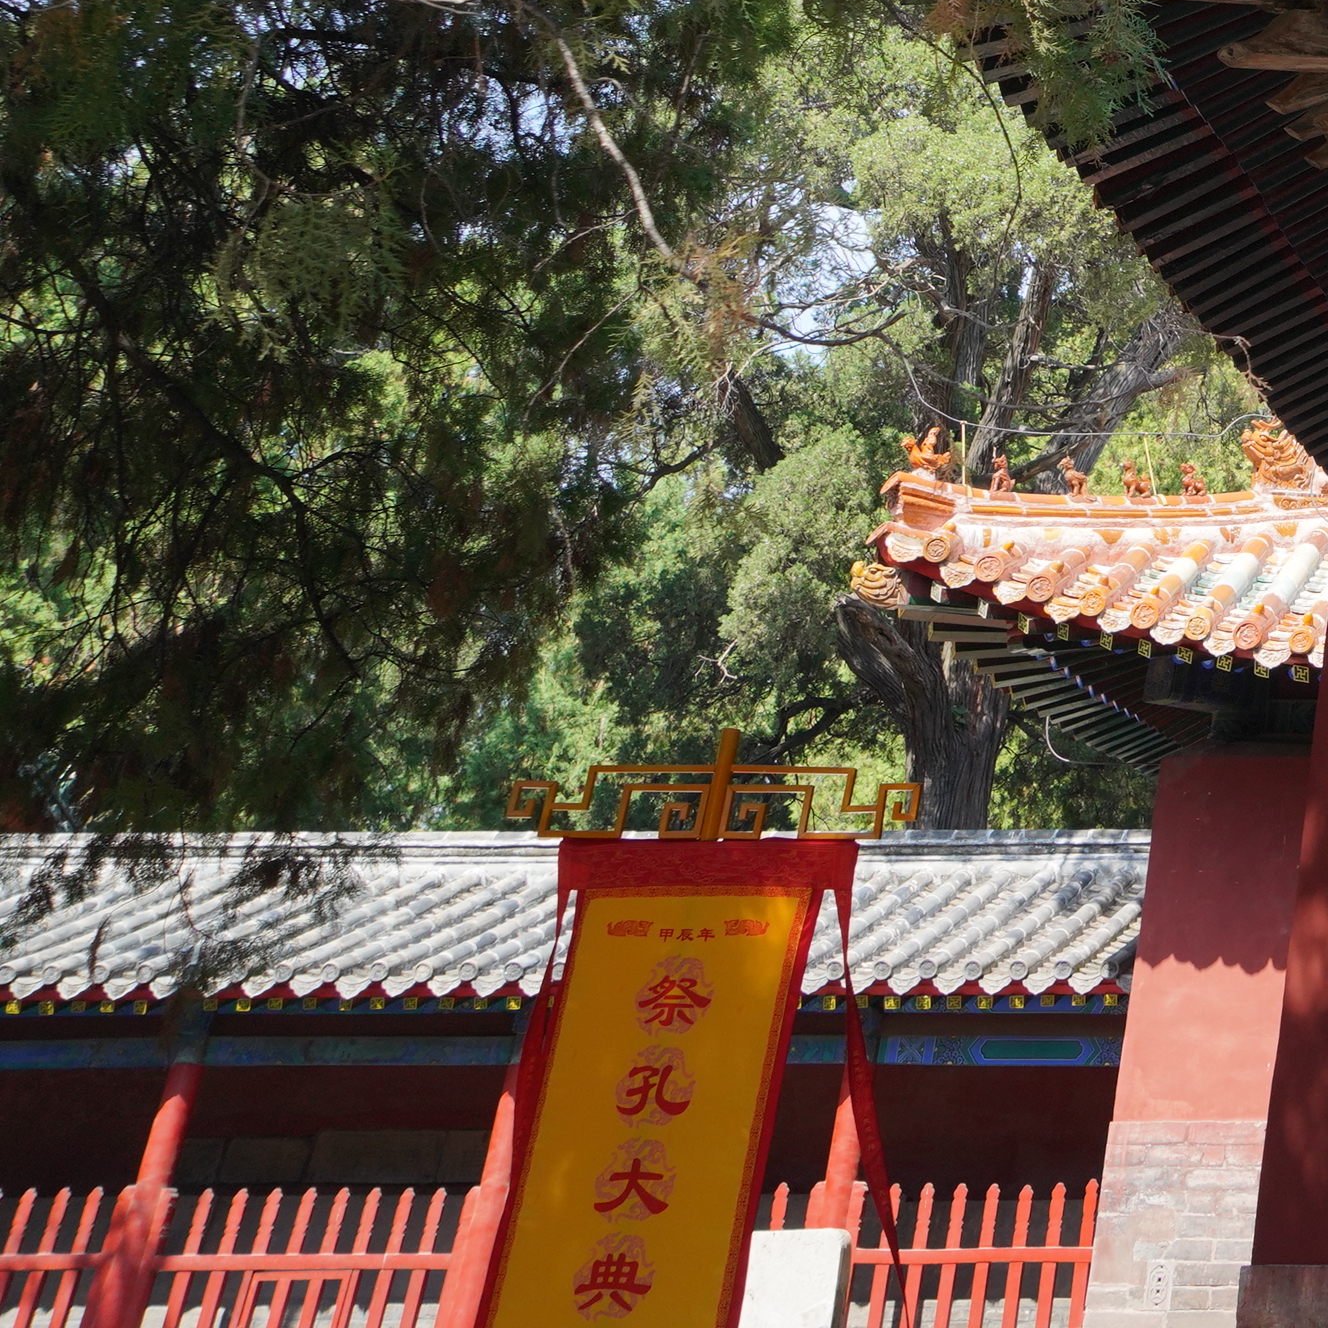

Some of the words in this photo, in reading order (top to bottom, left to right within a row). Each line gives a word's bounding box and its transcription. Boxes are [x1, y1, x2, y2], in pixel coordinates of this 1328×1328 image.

[659, 928, 716, 943] 甲辰年
[574, 975, 711, 1312] 祭孔大典
